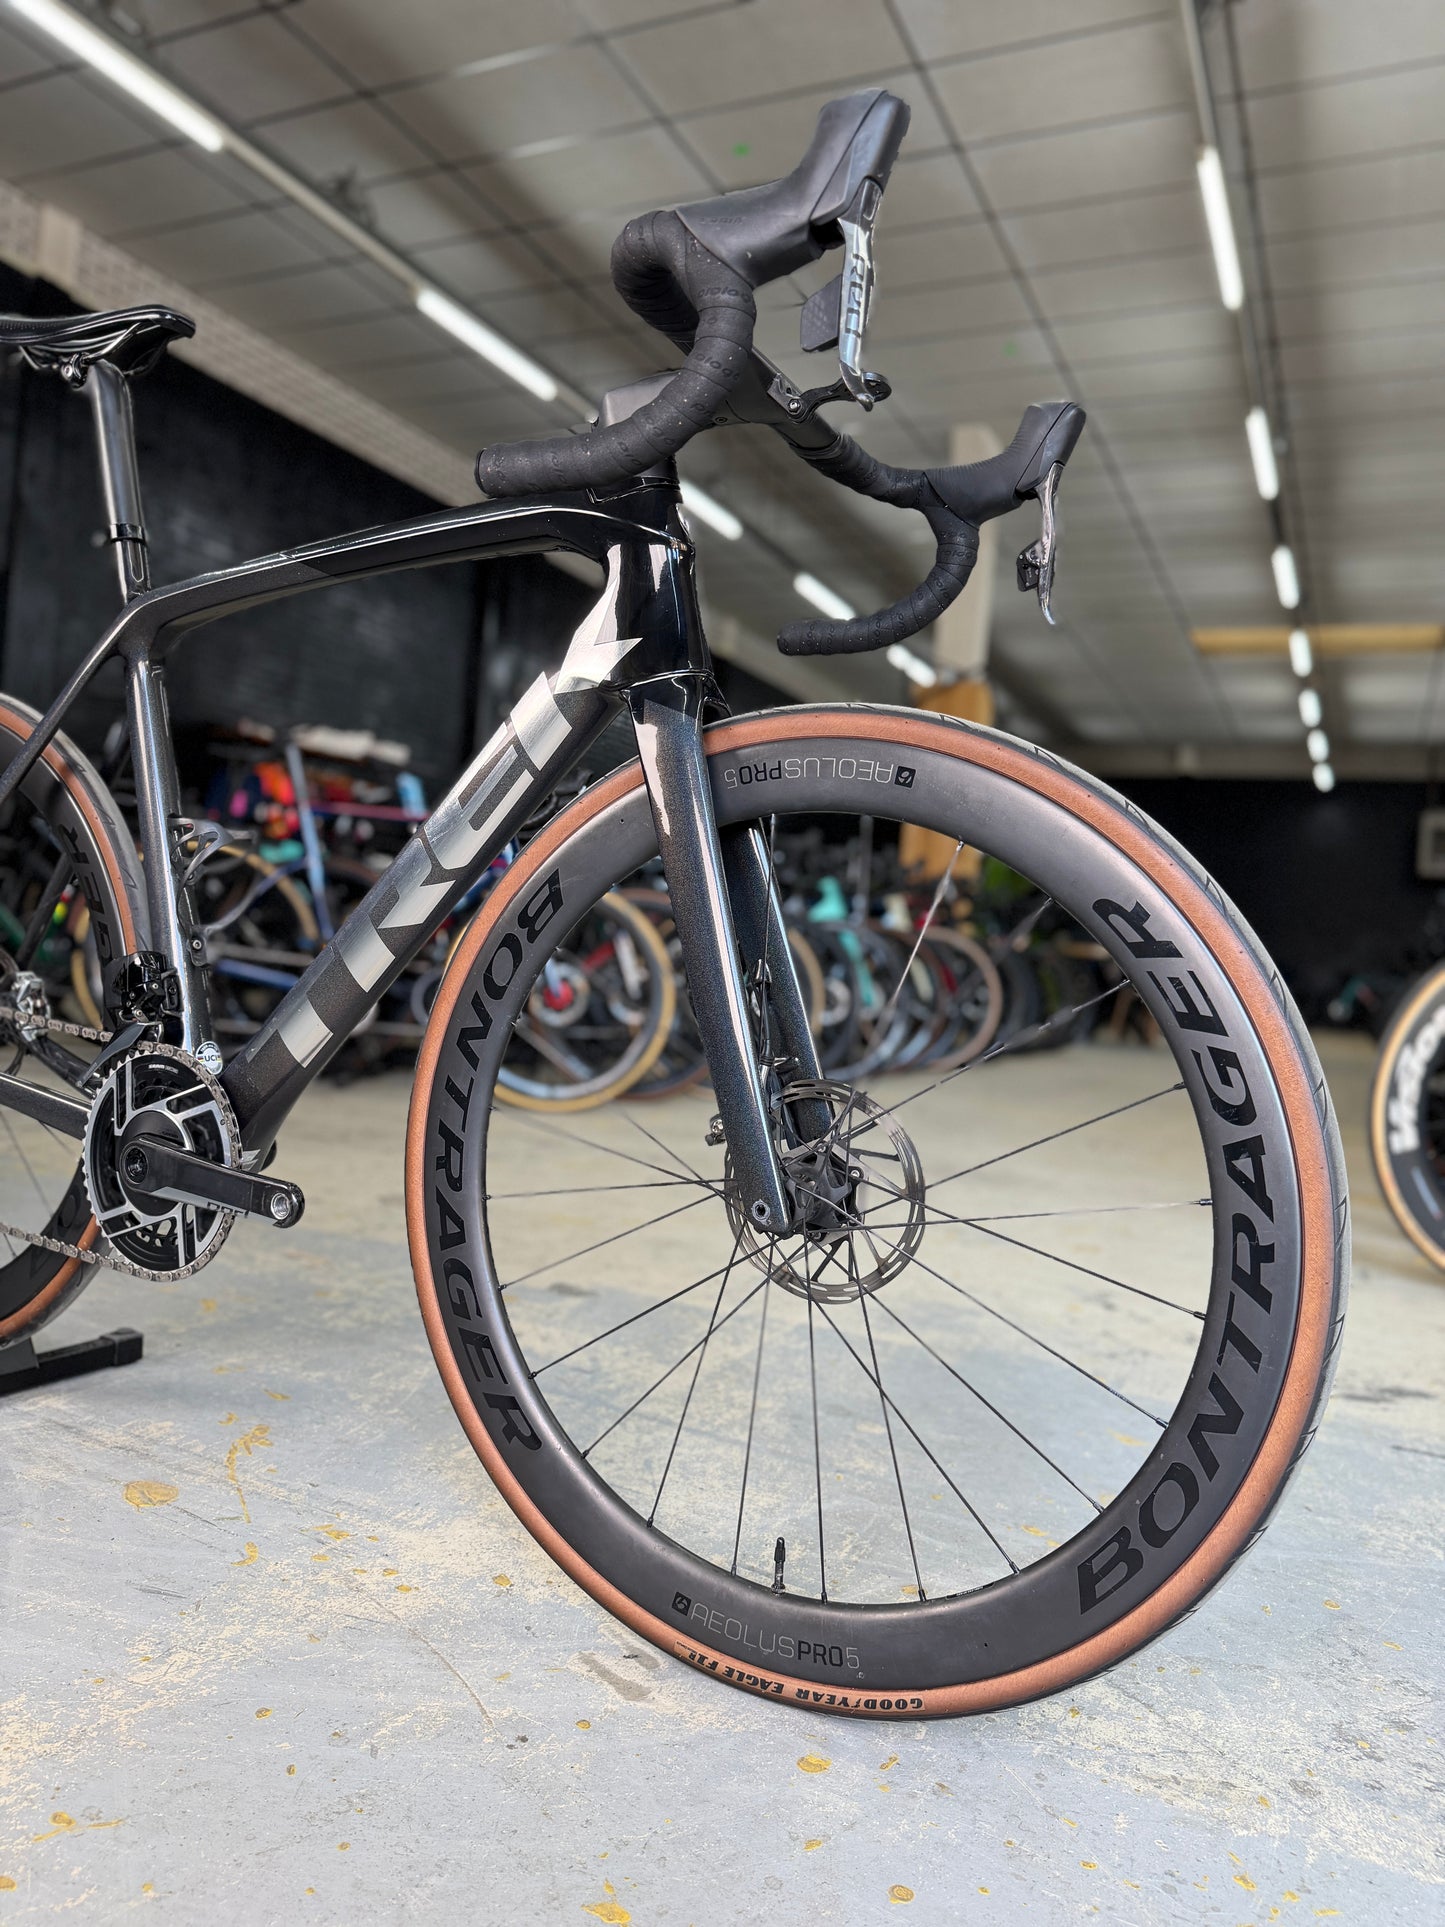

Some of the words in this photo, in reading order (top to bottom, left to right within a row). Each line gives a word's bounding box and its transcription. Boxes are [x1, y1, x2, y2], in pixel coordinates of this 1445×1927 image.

[245, 578, 643, 1068] TREK
[435, 868, 565, 1451] BONTRAGER
[1078, 897, 1275, 1615] BONTRAGER
[722, 1666, 784, 1694] EAGLE
[795, 1688, 923, 1711] GOODYEAR
